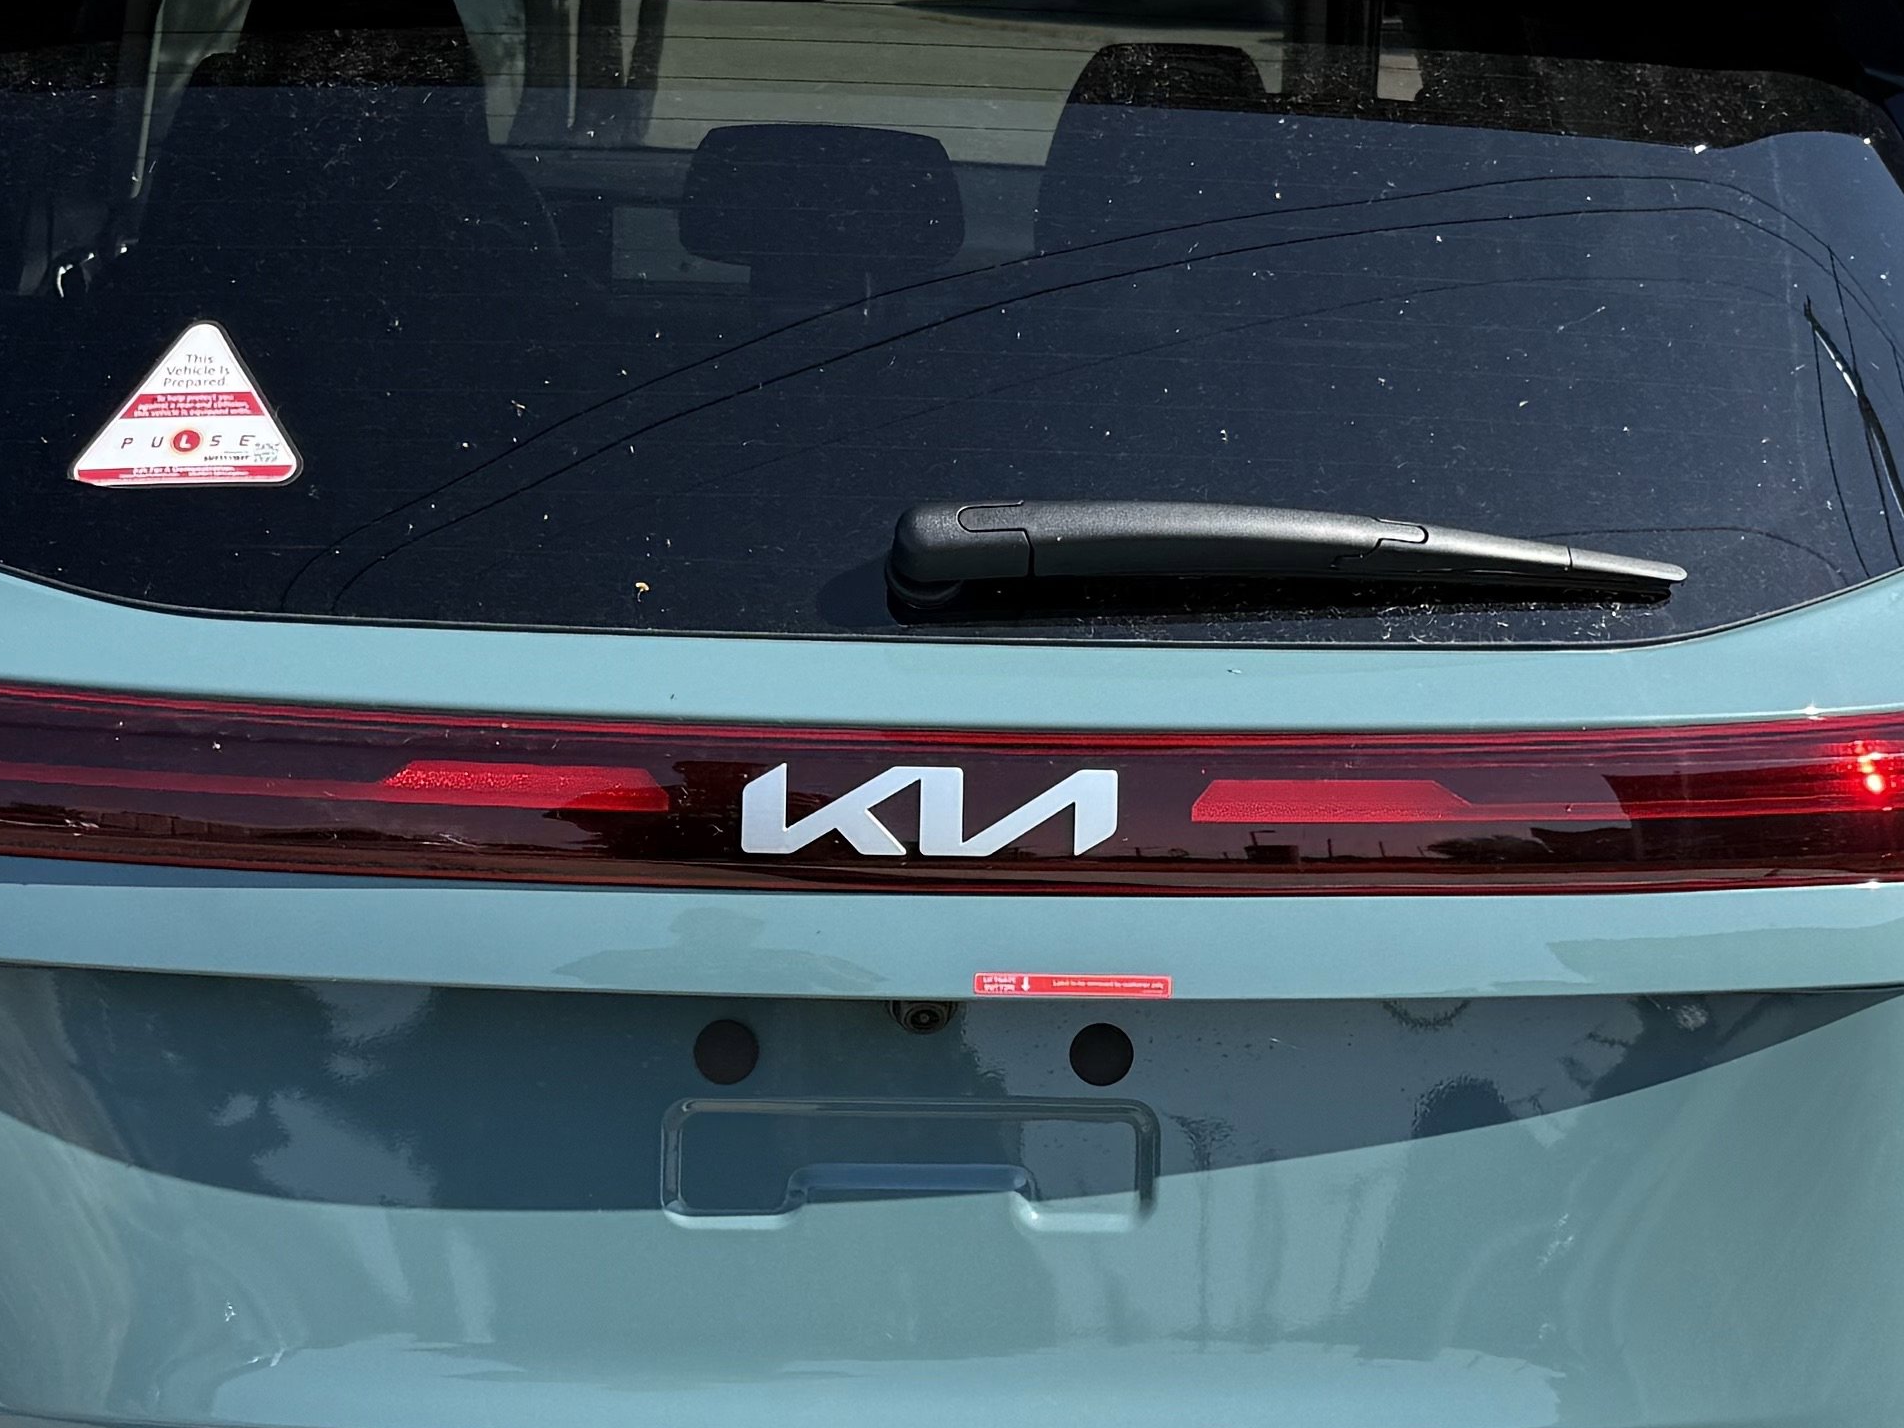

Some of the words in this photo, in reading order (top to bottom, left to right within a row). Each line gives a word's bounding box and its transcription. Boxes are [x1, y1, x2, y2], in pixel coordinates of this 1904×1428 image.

[186, 353, 213, 363] This
[166, 365, 215, 375] Vehicle
[220, 365, 230, 374] Is
[120, 433, 256, 449] PULSE
[741, 762, 1119, 857] KIA
